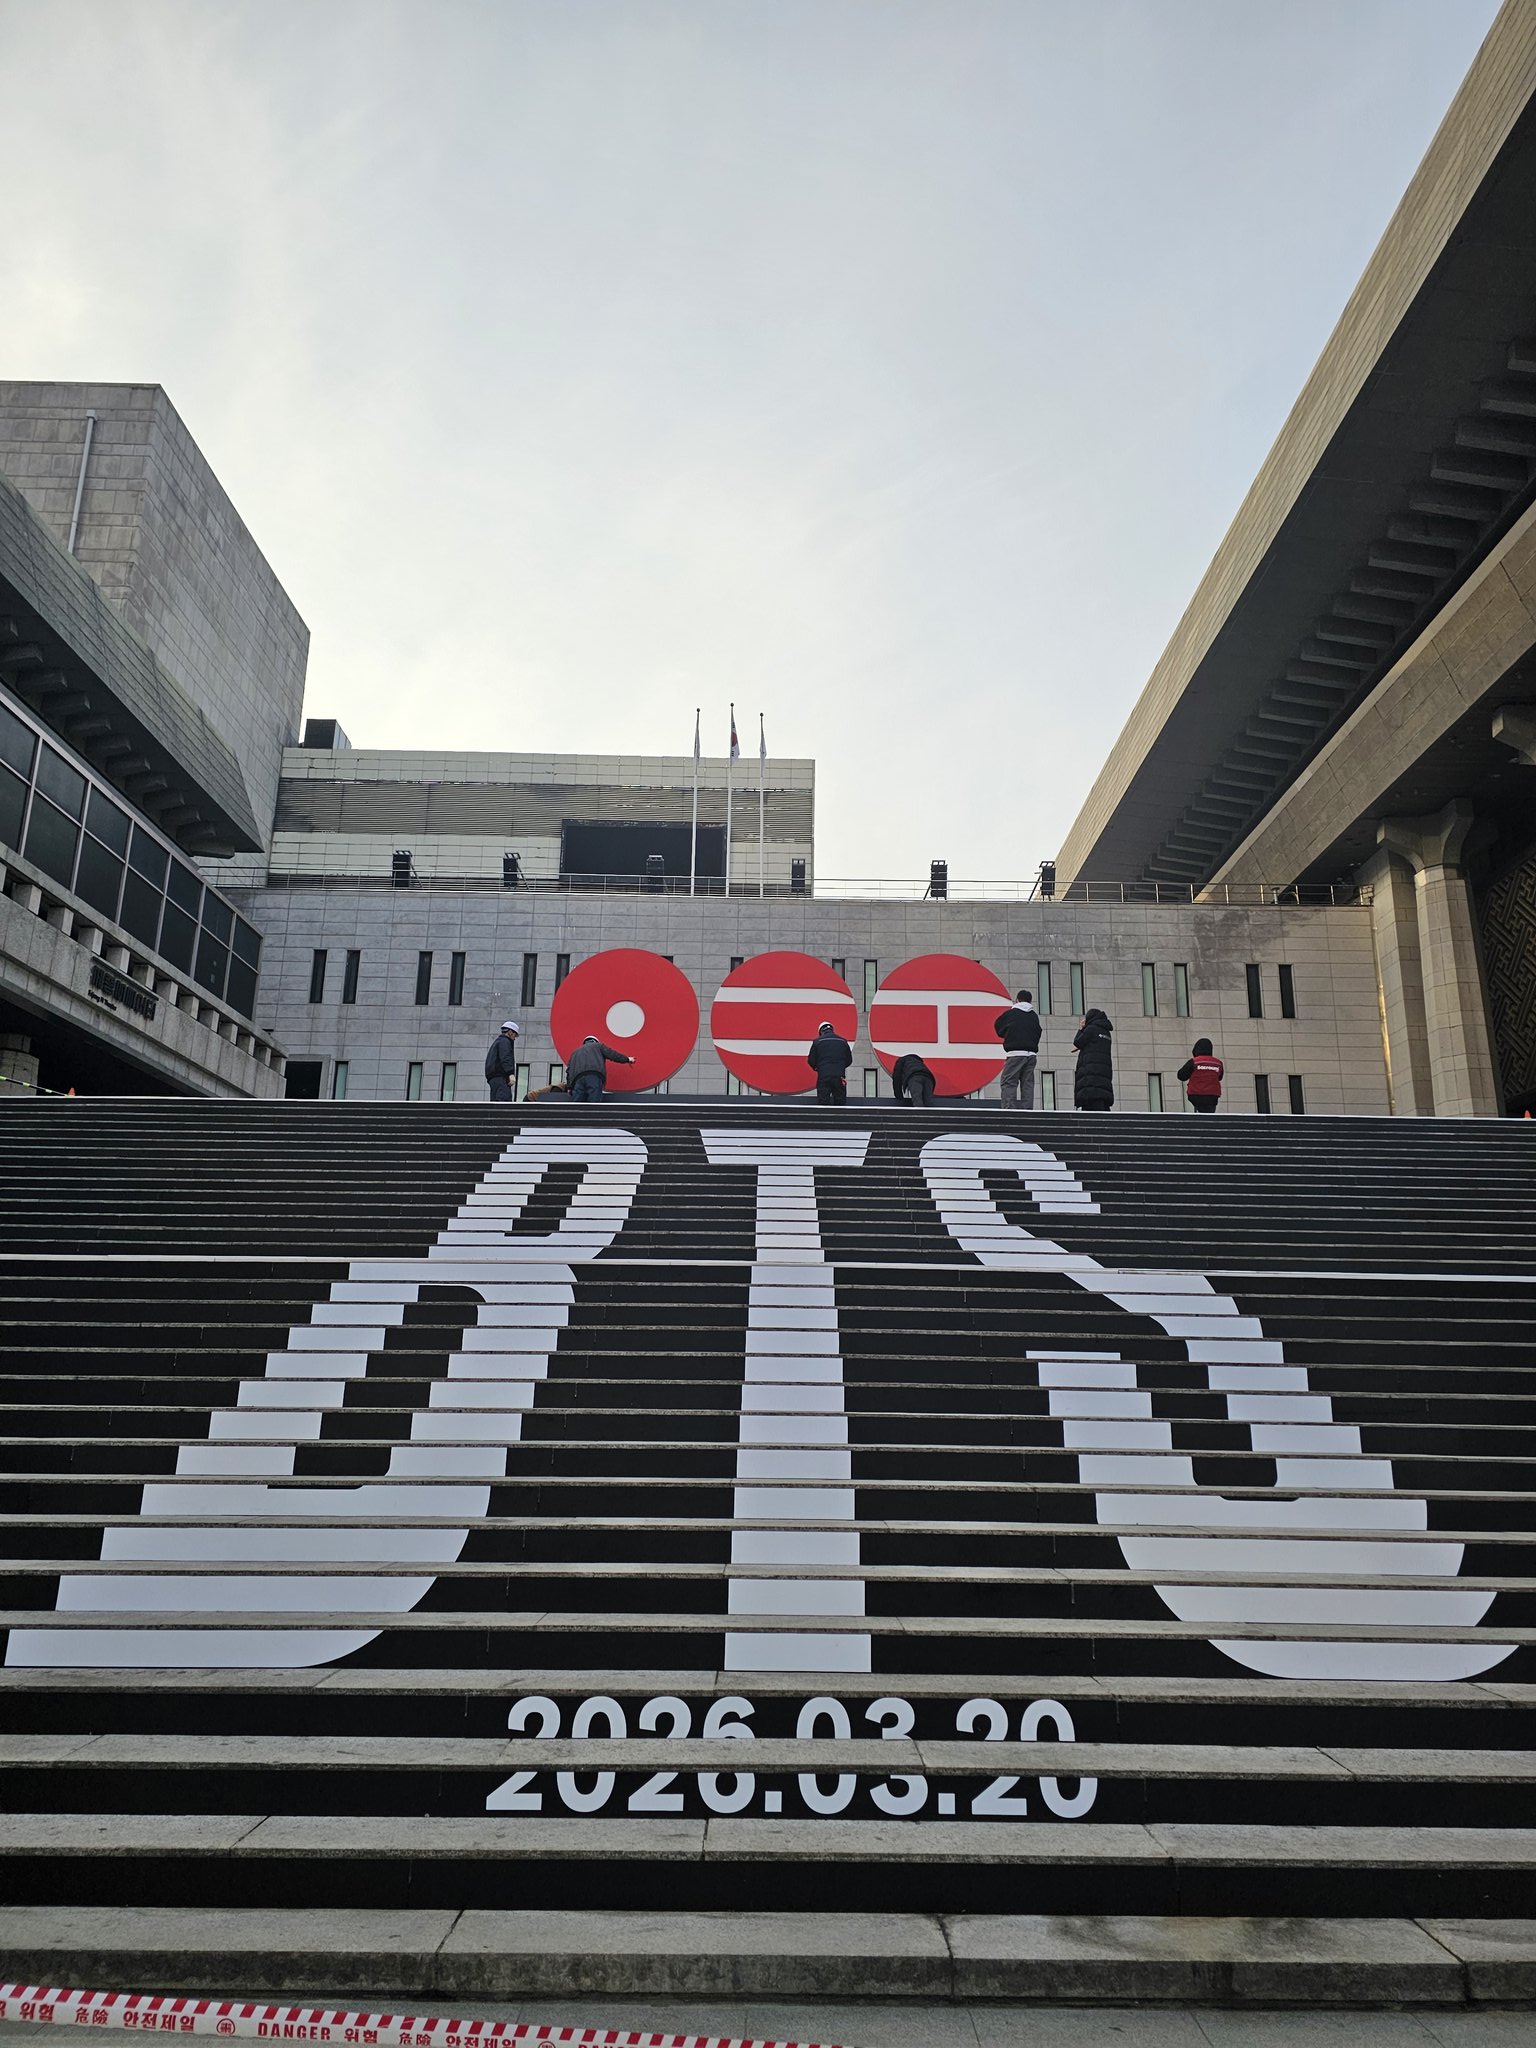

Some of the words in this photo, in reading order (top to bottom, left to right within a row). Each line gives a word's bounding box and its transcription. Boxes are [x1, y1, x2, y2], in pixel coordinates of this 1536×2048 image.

[5, 1126, 1519, 1682] BTS
[485, 1695, 1099, 1819] 2026.03.20
[20, 2001, 55, 2021] 위험
[75, 2006, 109, 2025] 危險
[123, 2011, 195, 2032] 안전제일
[257, 2022, 331, 2041] DANGER
[344, 2027, 378, 2044] 위험
